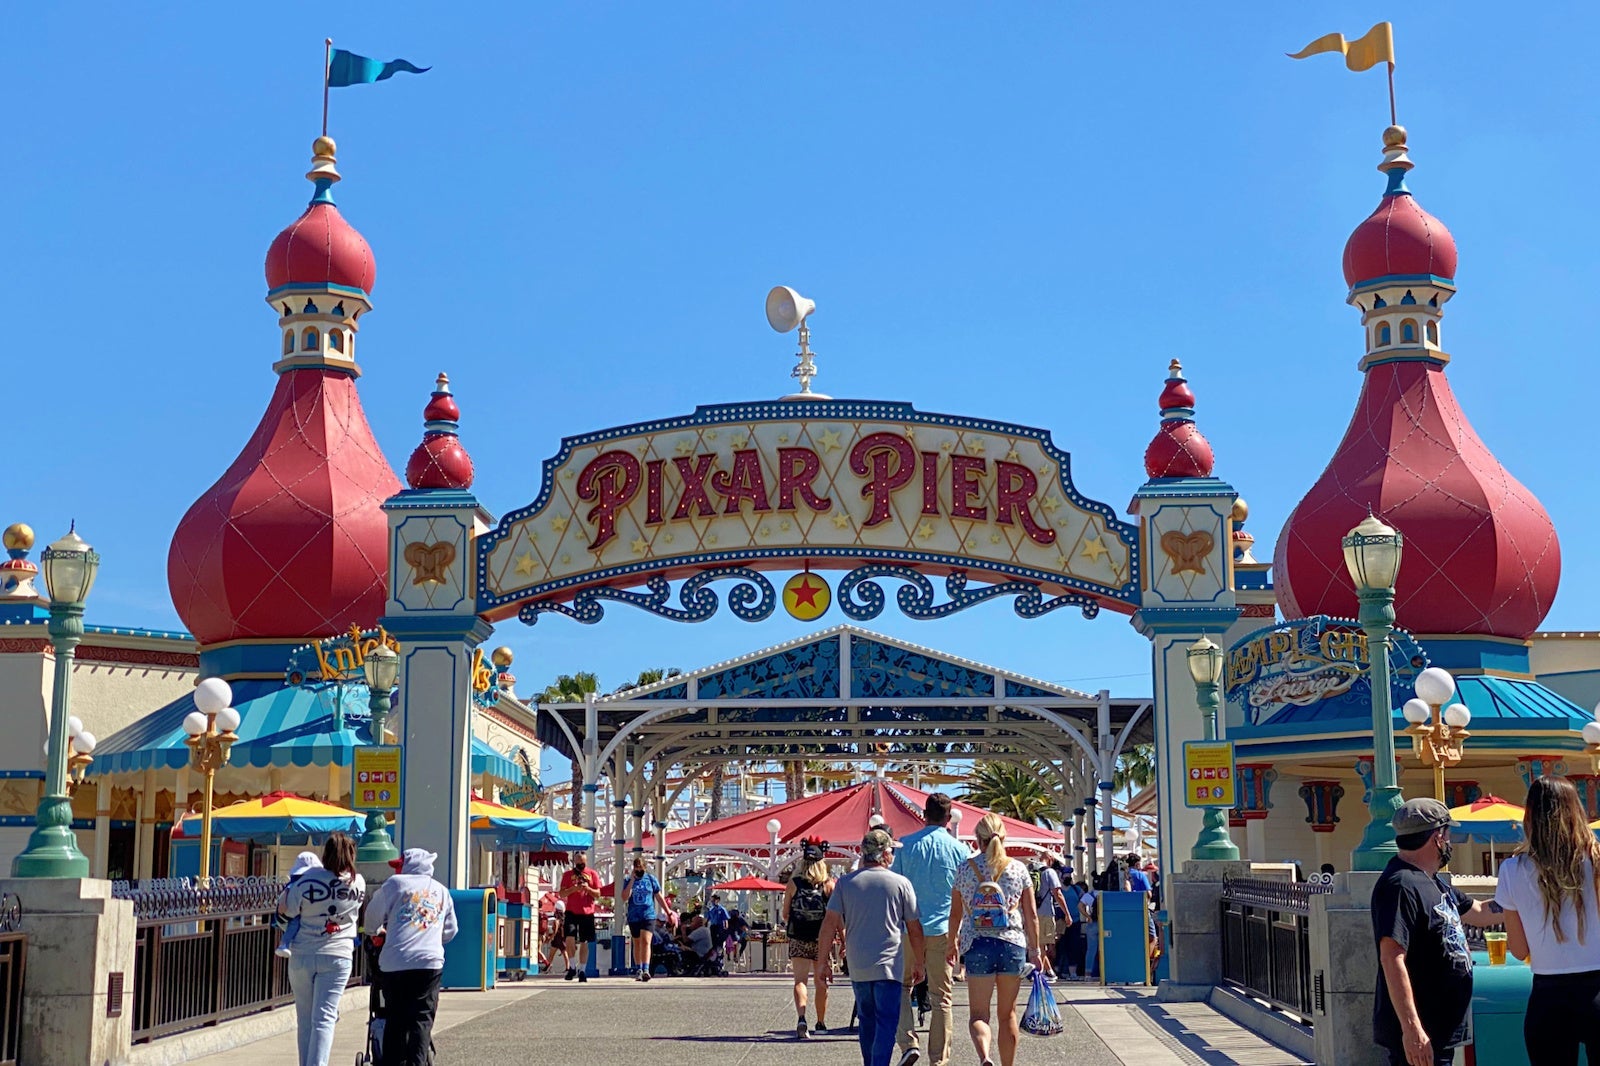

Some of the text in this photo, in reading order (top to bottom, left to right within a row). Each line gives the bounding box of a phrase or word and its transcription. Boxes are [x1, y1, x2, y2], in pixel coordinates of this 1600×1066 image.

[576, 431, 1058, 551] PIXAR PIER
[1249, 672, 1354, 707] Lounge
[297, 879, 365, 904] DISNE
